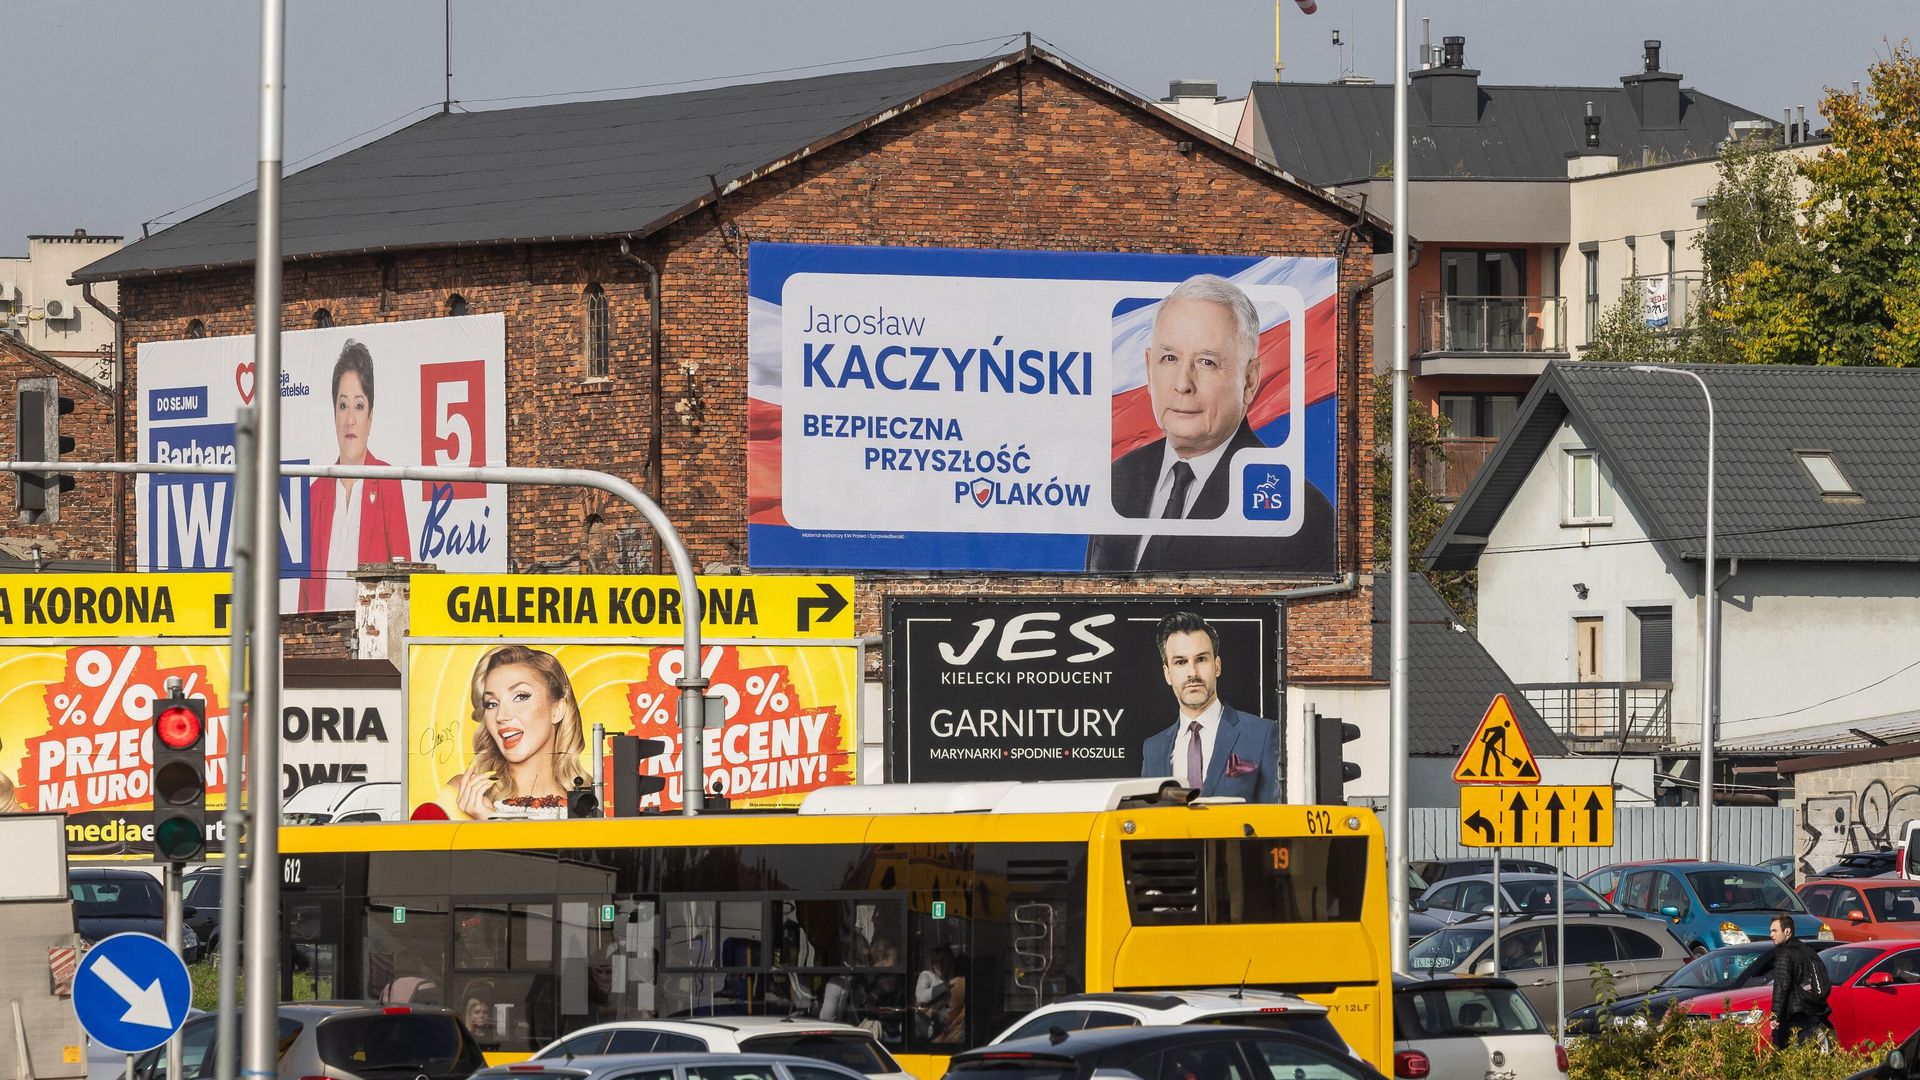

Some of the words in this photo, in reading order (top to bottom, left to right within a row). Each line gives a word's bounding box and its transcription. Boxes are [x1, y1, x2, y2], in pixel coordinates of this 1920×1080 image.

[803, 305, 926, 336] Jarosław
[803, 336, 1092, 396] KACZYŃSKI
[157, 397, 170, 411] DO
[170, 396, 198, 410] SEJMU
[435, 380, 472, 468] 5
[803, 414, 963, 441] BEZPIECZNA
[157, 439, 236, 475] Barbara
[864, 443, 1031, 474] PRZYSZŁOŚĆ
[157, 478, 303, 571] IWN
[420, 482, 491, 561] Basi
[24, 586, 175, 625] KORONA
[447, 586, 598, 624] GALERIA
[938, 612, 1116, 666] JES
[941, 671, 1011, 685] KIELECKI
[1016, 671, 1112, 684] PRODUCENT
[930, 708, 1125, 738] GARNITURY
[930, 748, 1002, 760] MARYNARKI
[1010, 748, 1063, 759] SPODNIE
[1072, 747, 1126, 759] KOSZULE
[38, 783, 80, 812] NA
[1306, 810, 1333, 834] 612
[284, 858, 301, 883] 612
[1270, 847, 1289, 870] 19
[1345, 1004, 1371, 1012] 12LF
